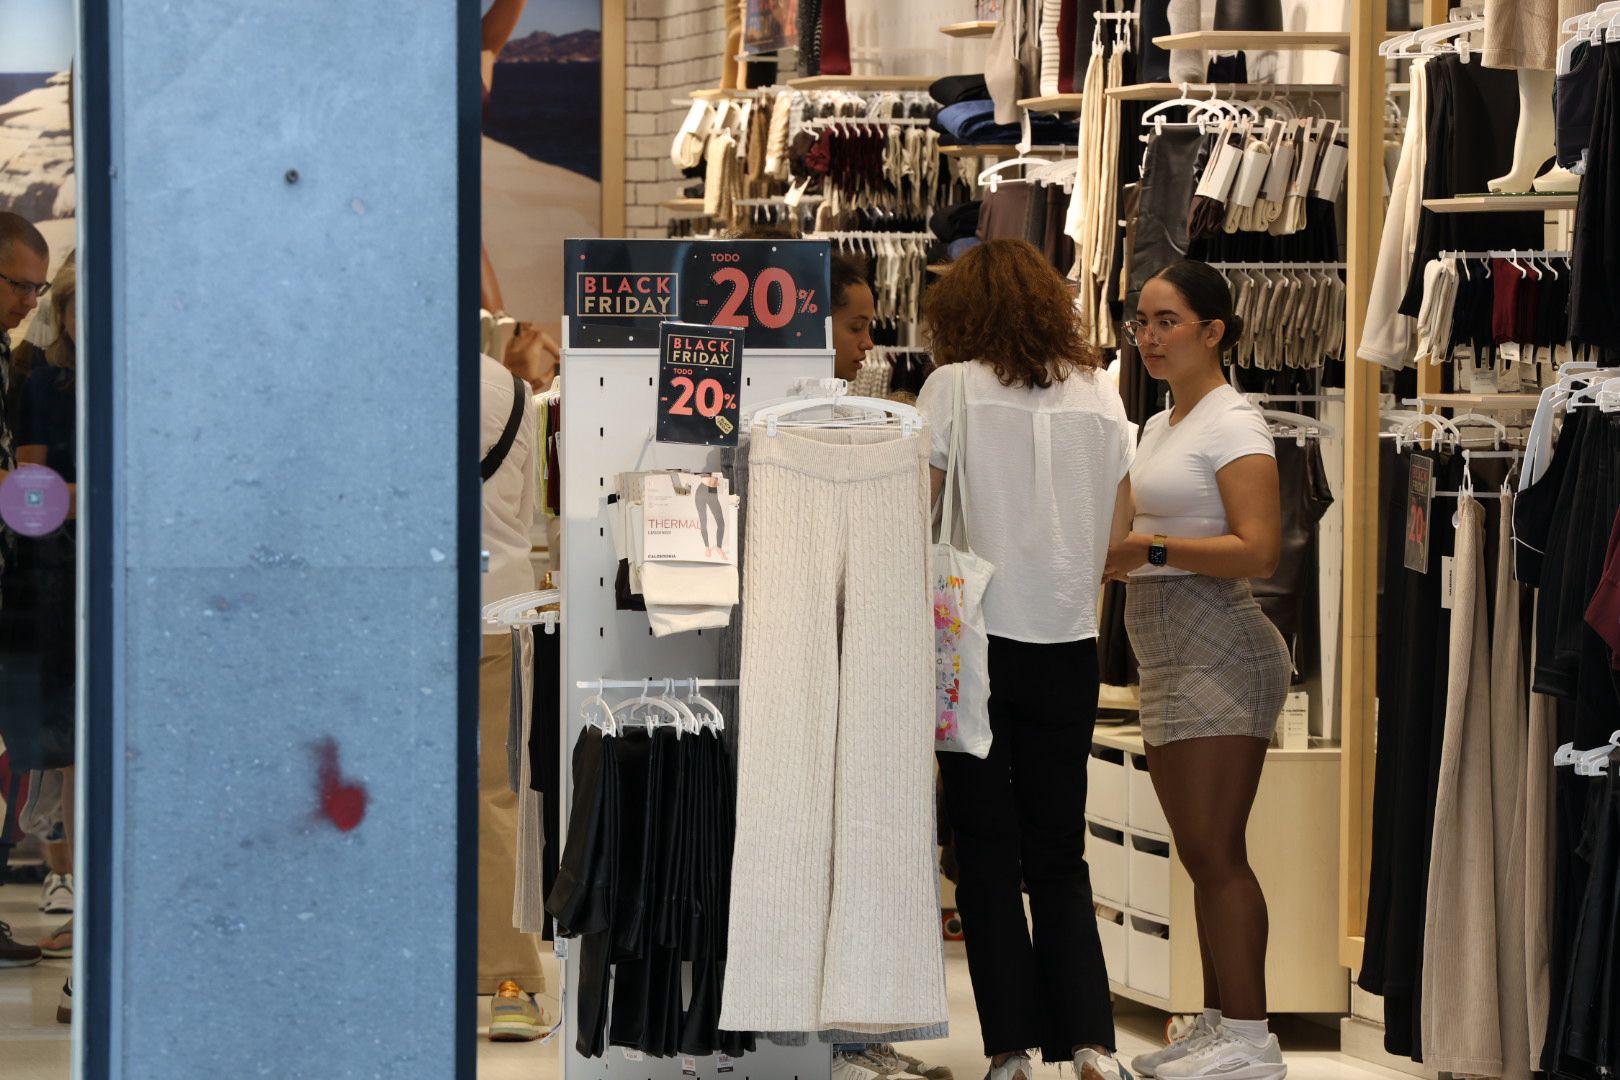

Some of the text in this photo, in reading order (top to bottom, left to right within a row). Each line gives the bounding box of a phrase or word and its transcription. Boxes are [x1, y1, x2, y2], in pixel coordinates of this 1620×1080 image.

[711, 253, 740, 263] TODO
[584, 277, 671, 294] BLACK
[584, 296, 671, 313] FRIDAY
[673, 338, 730, 352] BLACK
[672, 350, 730, 365] FRIDAY
[661, 376, 737, 417] -20%
[648, 519, 702, 530] THERMAL
